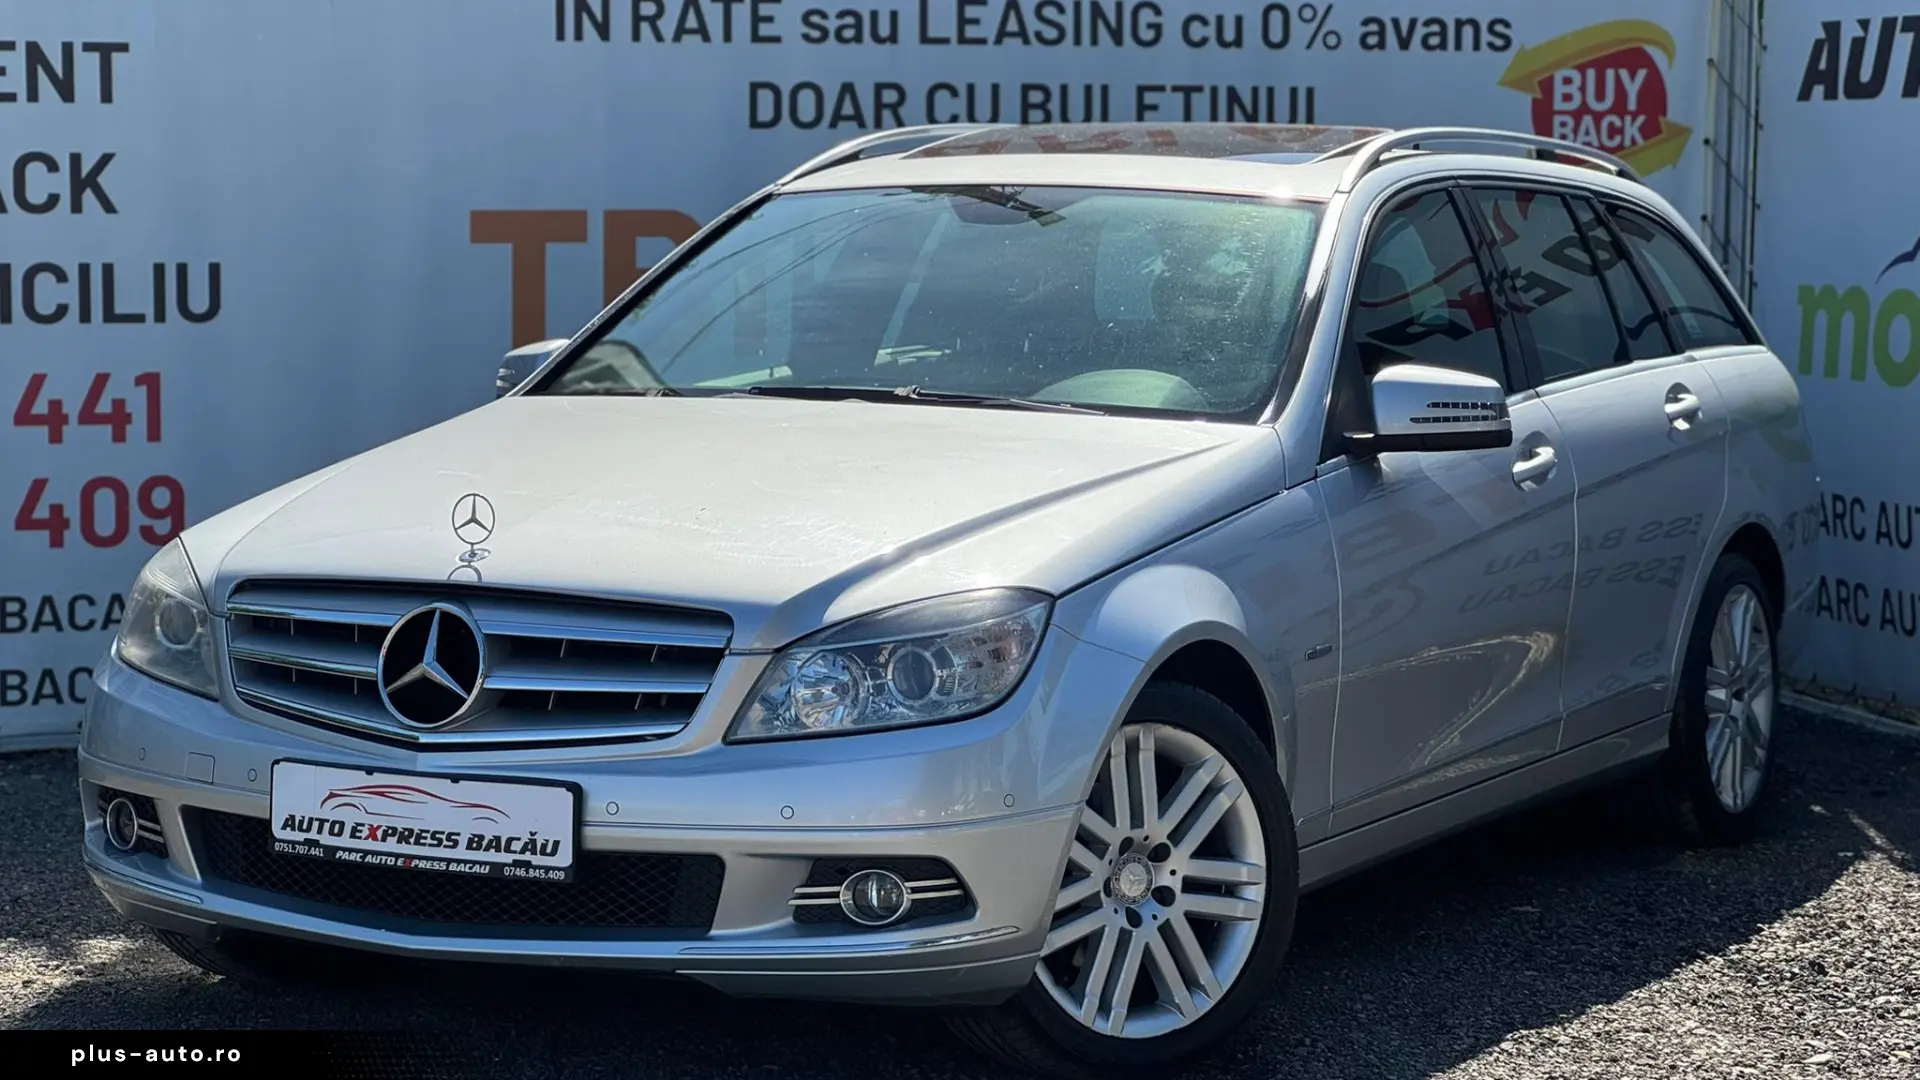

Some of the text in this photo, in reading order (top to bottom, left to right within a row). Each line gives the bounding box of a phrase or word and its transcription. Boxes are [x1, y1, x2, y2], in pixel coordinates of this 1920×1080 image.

[555, 0, 1514, 53] IN RATE sau LEASING cu 0% avans
[749, 81, 907, 130] DOAR
[925, 82, 1001, 125] CU
[1552, 67, 1648, 112] BUY
[1552, 113, 1648, 149] BACK
[0, 151, 119, 215] CK
[13, 371, 163, 444] 441
[14, 475, 186, 549] 409
[1879, 588, 1920, 638] AU
[274, 841, 325, 858] 0751.707.441
[280, 813, 561, 858] AUTO EXPRESS BACĂU
[335, 850, 491, 874] PARC AUTO EXPRESS BACAU
[503, 865, 566, 881] 0746.845.409
